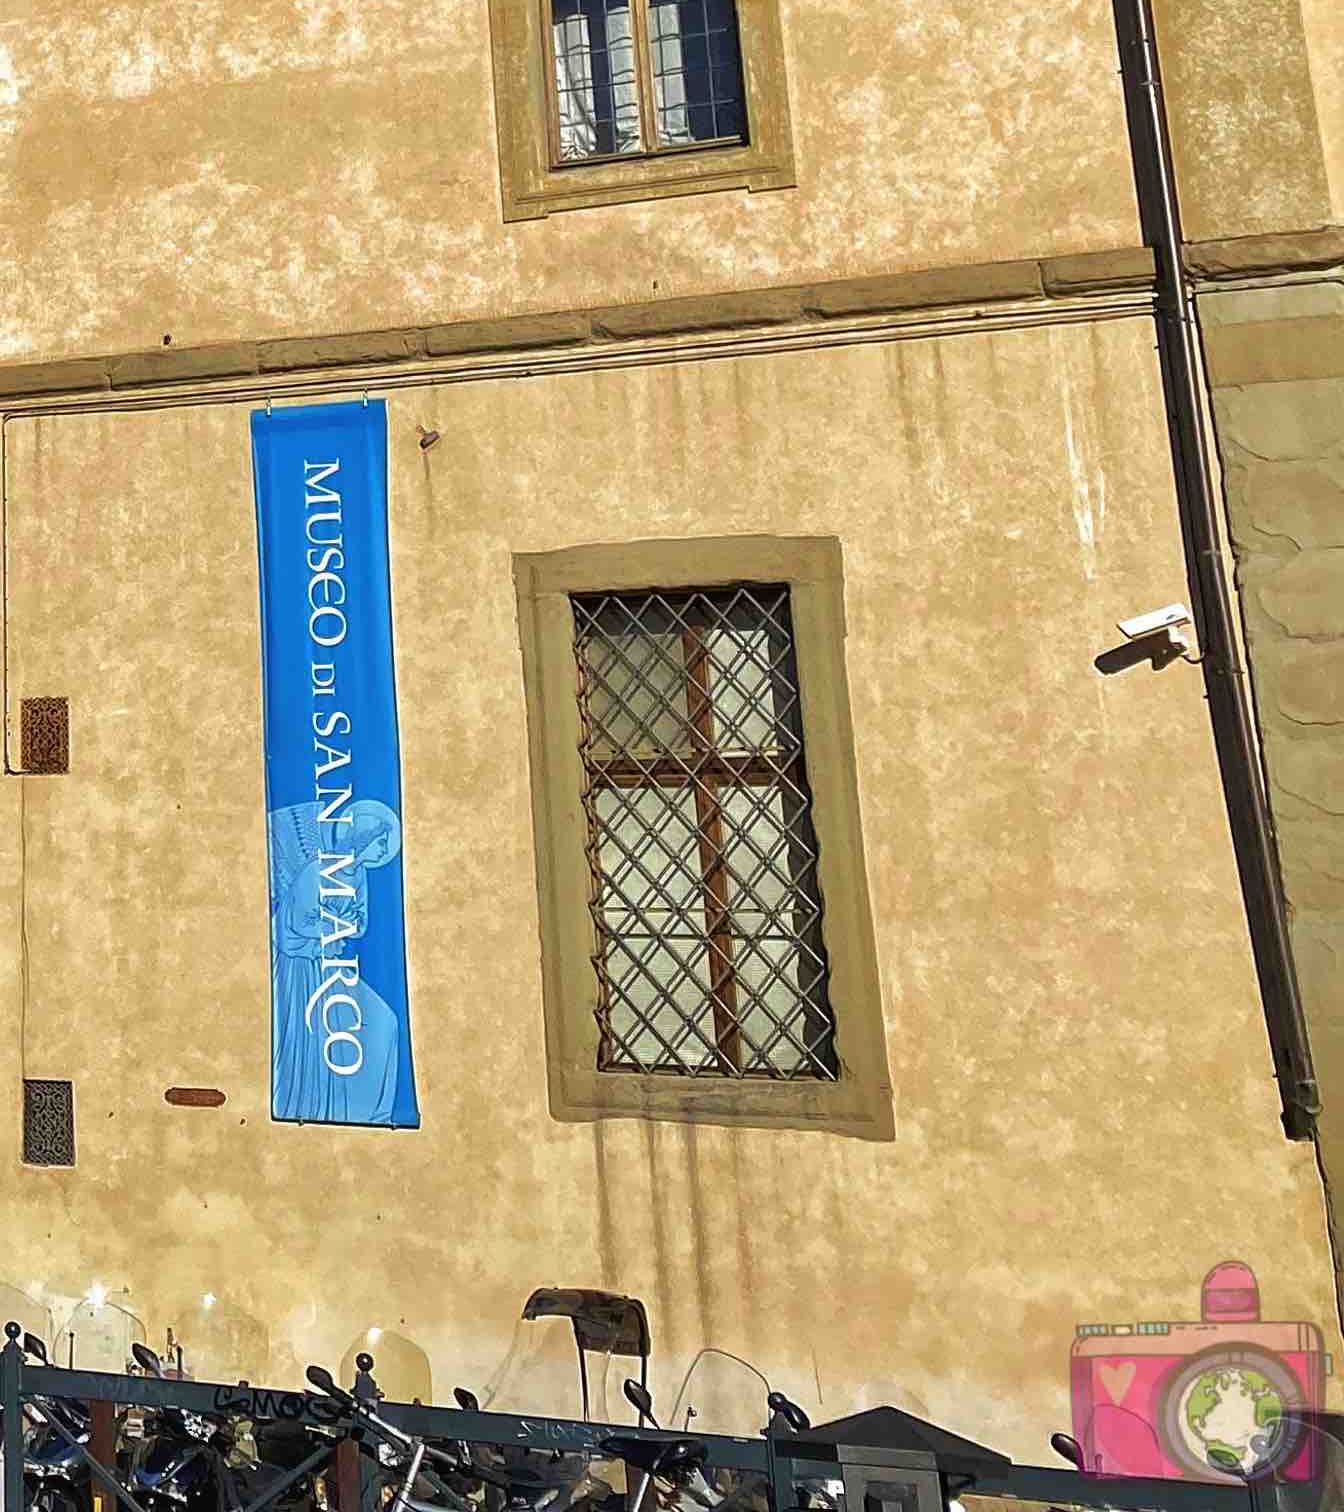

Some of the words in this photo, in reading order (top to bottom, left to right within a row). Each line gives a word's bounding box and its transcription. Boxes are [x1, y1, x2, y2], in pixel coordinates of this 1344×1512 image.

[303, 457, 348, 647] MUSEO
[311, 661, 336, 697] DI
[311, 711, 354, 825] SAN
[305, 848, 364, 1076] MARCO
